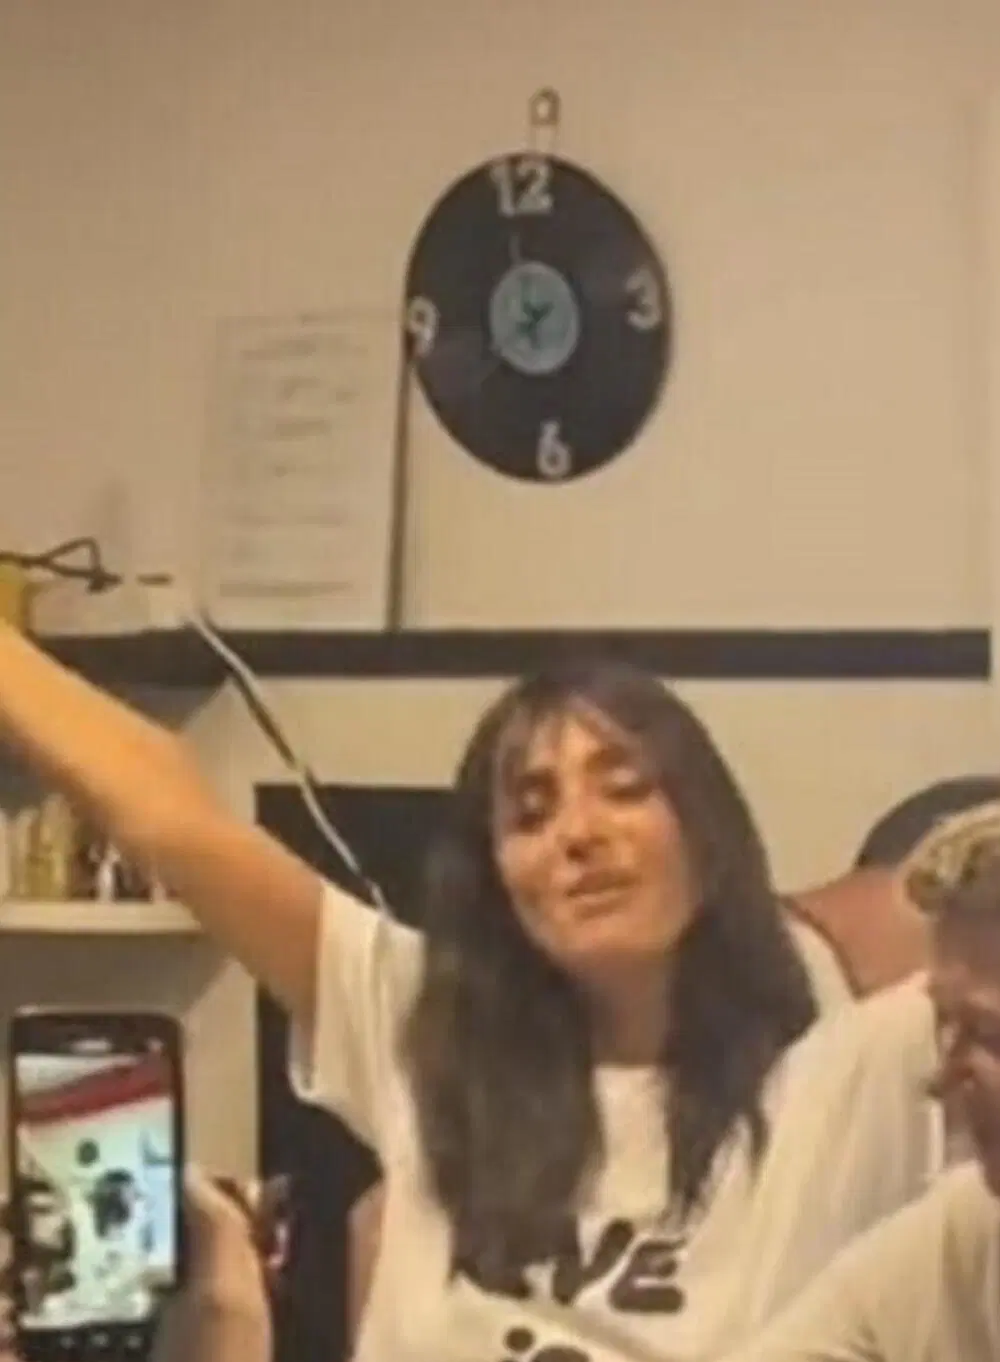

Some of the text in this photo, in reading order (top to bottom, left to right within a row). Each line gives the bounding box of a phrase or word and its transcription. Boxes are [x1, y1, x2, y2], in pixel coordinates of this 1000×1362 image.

[490, 158, 553, 217] 12
[407, 296, 440, 355] 9
[624, 266, 662, 332] 3
[535, 419, 572, 478] 6
